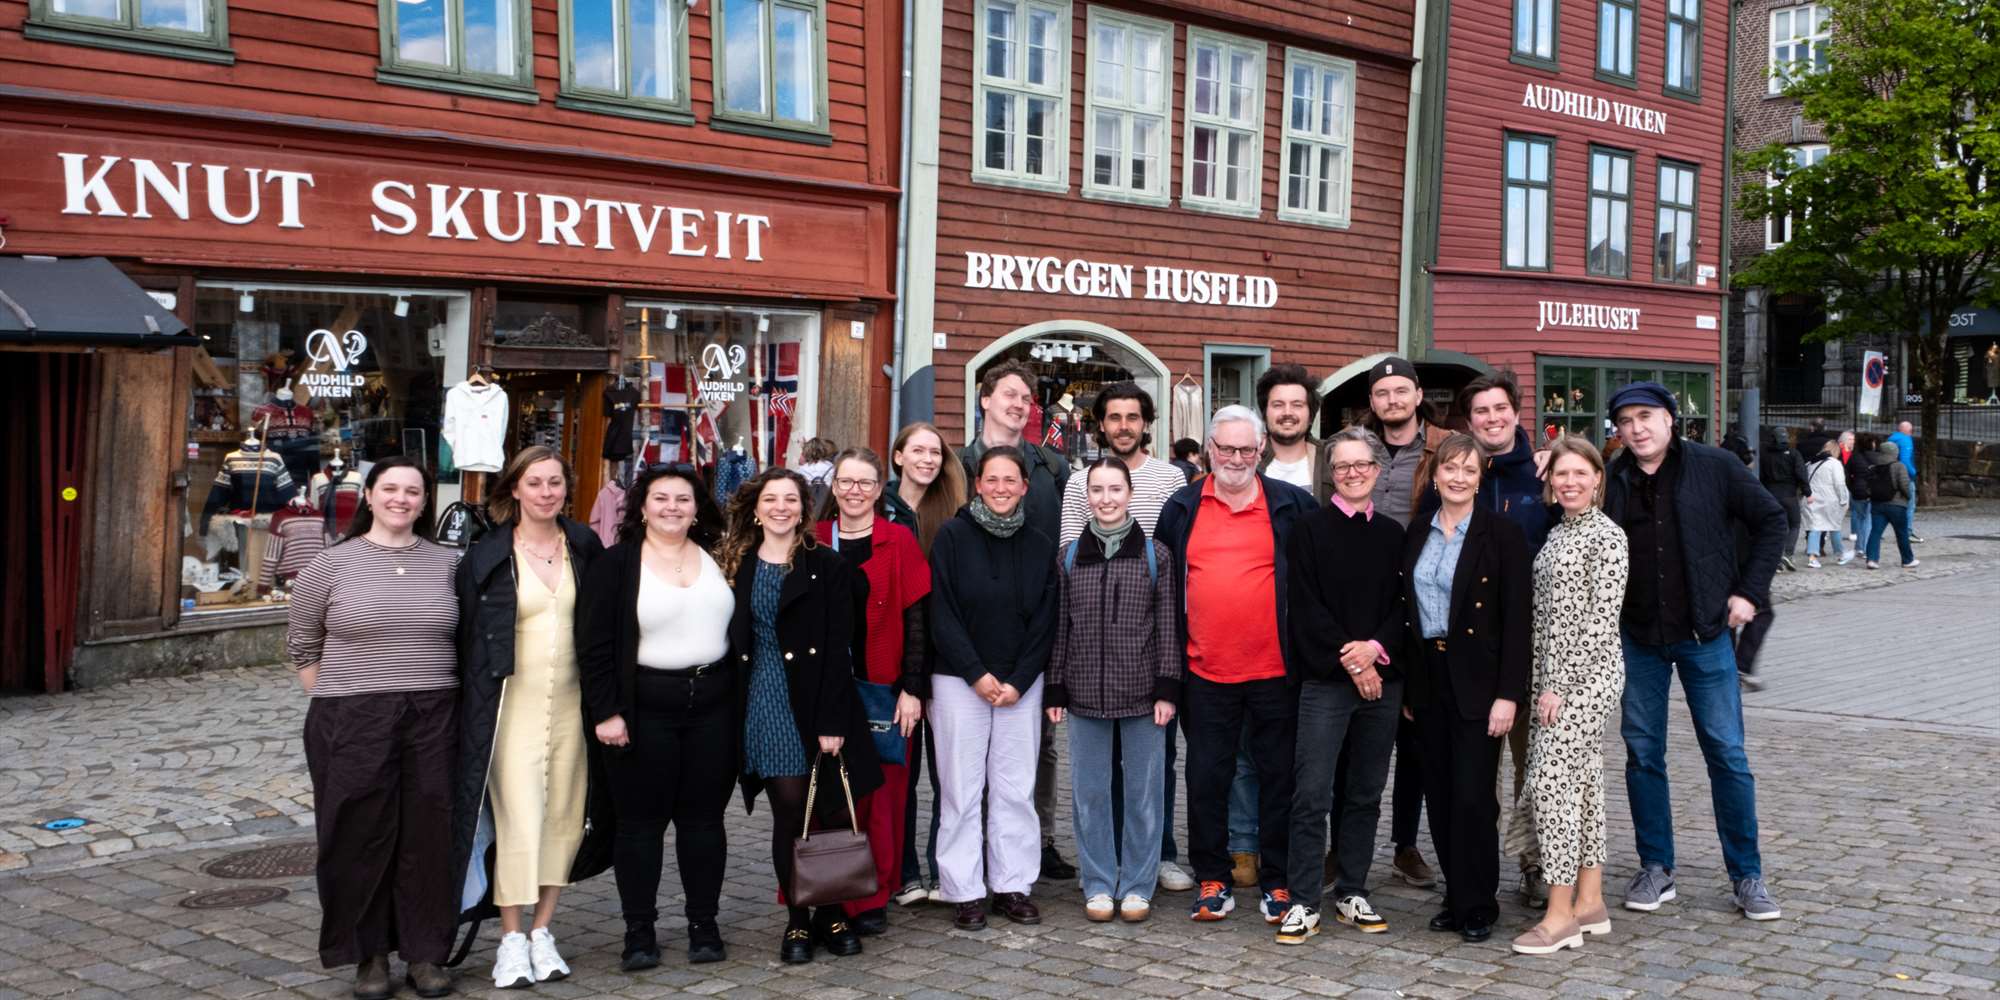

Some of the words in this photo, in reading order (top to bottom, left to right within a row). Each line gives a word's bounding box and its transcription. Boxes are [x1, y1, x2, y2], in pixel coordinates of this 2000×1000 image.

[1522, 83, 1610, 122] AUDHILD
[1613, 102, 1668, 135] VIKEN
[57, 153, 315, 228] KNUT
[370, 180, 771, 261] SKURTVEIT
[965, 251, 1134, 299] BRYGGEN
[1144, 265, 1279, 308] HUSFLID
[1536, 300, 1641, 332] JULEHUSET
[299, 374, 365, 386] AUDHILD
[307, 385, 352, 397] VIKEN
[697, 381, 744, 392] AUDHILD
[704, 391, 736, 401] VIKEN
